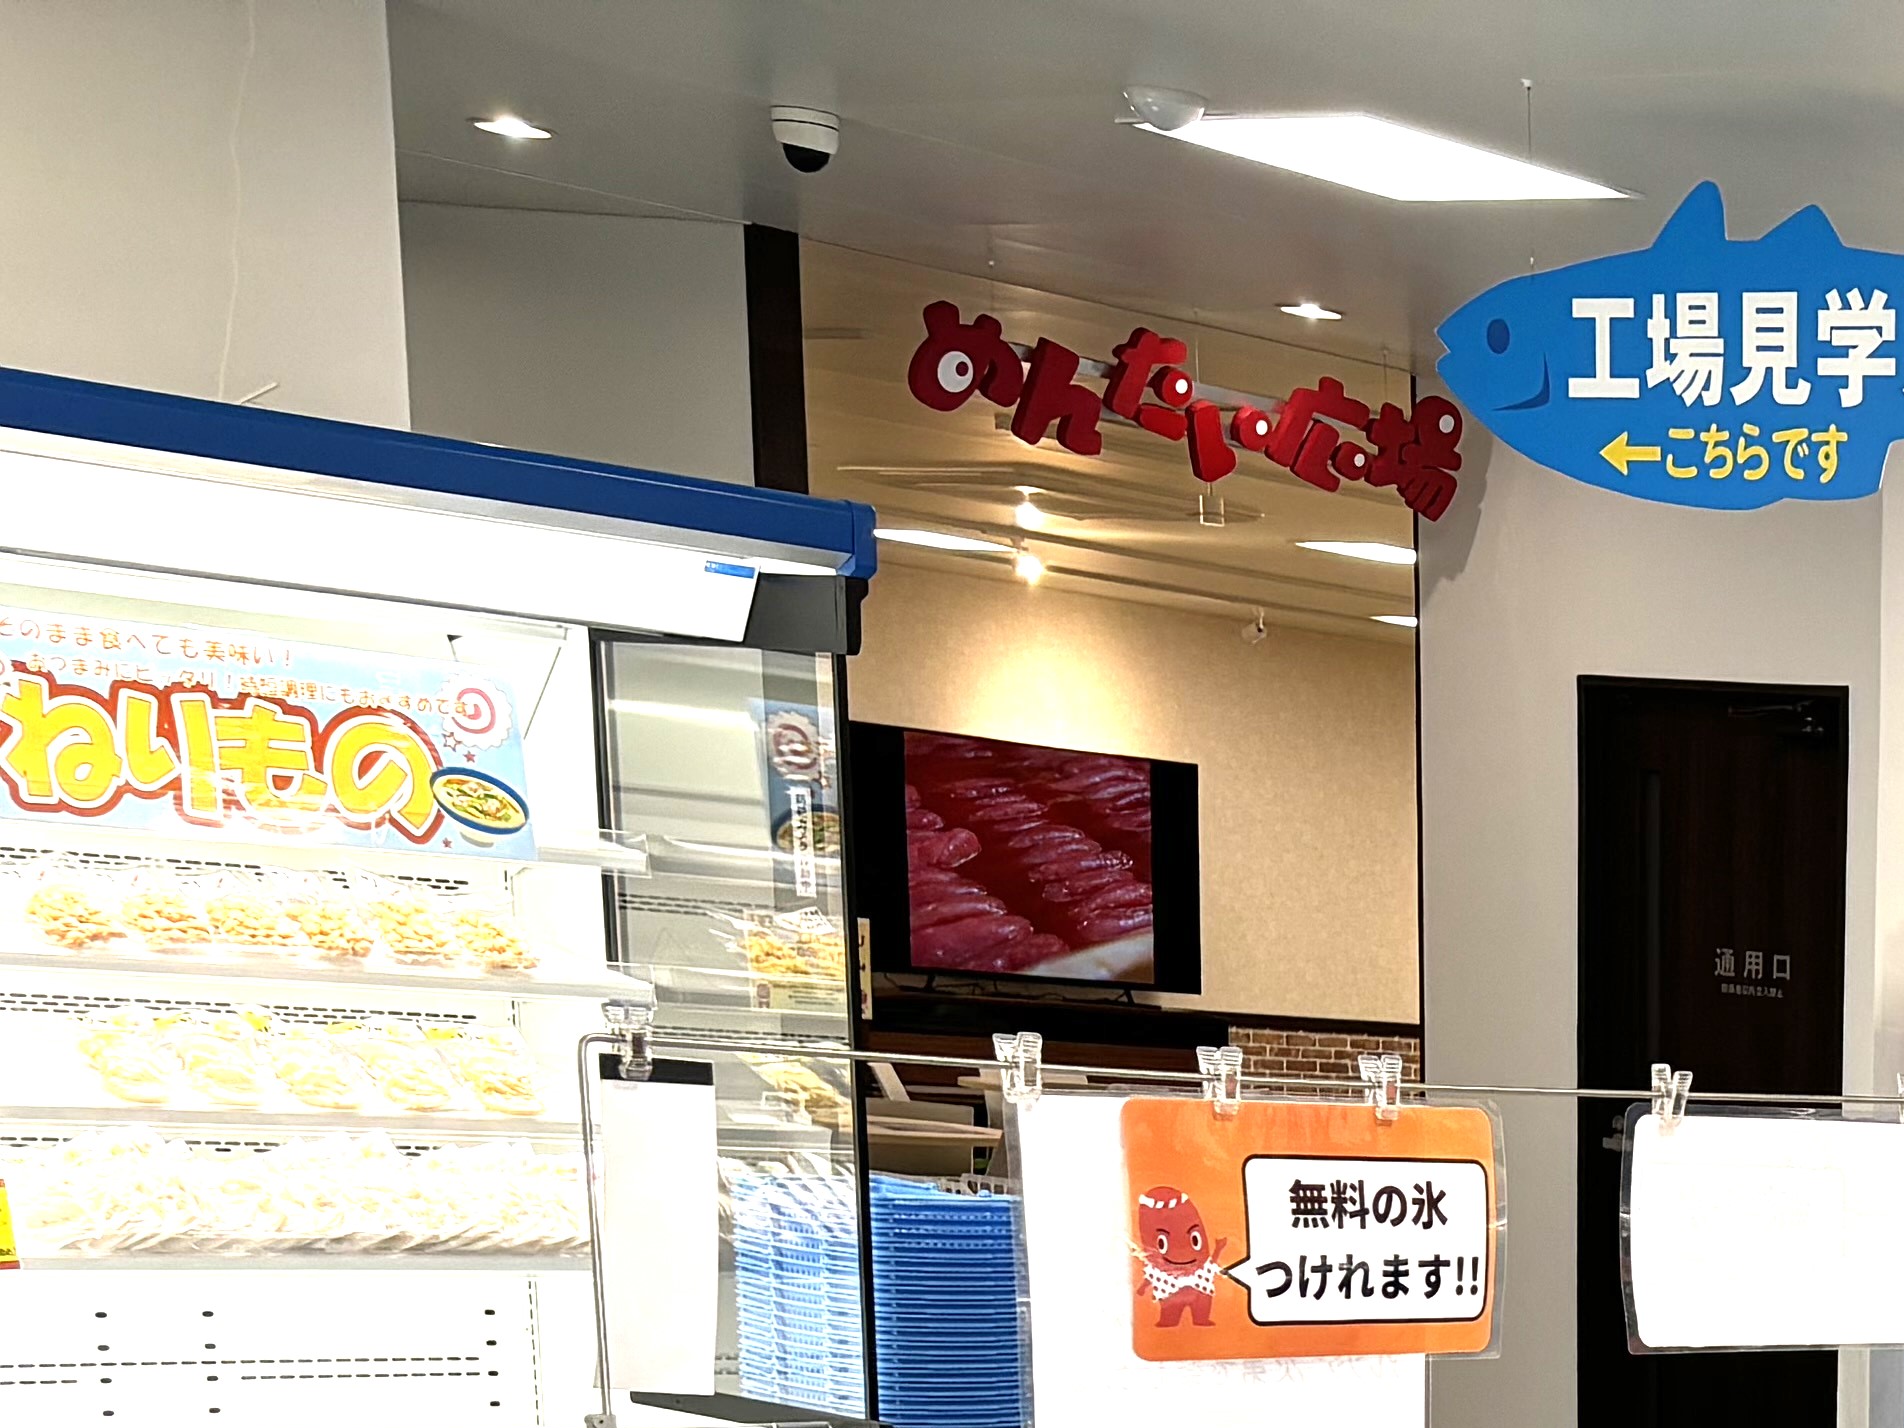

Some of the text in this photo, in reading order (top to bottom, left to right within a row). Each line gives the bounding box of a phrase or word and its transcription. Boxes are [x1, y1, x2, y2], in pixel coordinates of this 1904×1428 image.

[907, 299, 1463, 522] めんたい広場
[1664, 422, 1849, 484] こちらです
[3, 672, 440, 835] ねりもの
[1714, 948, 1790, 980] 通用口
[1289, 1179, 1448, 1230] 無料の氷
[1255, 1254, 1479, 1300] つけれます!!
